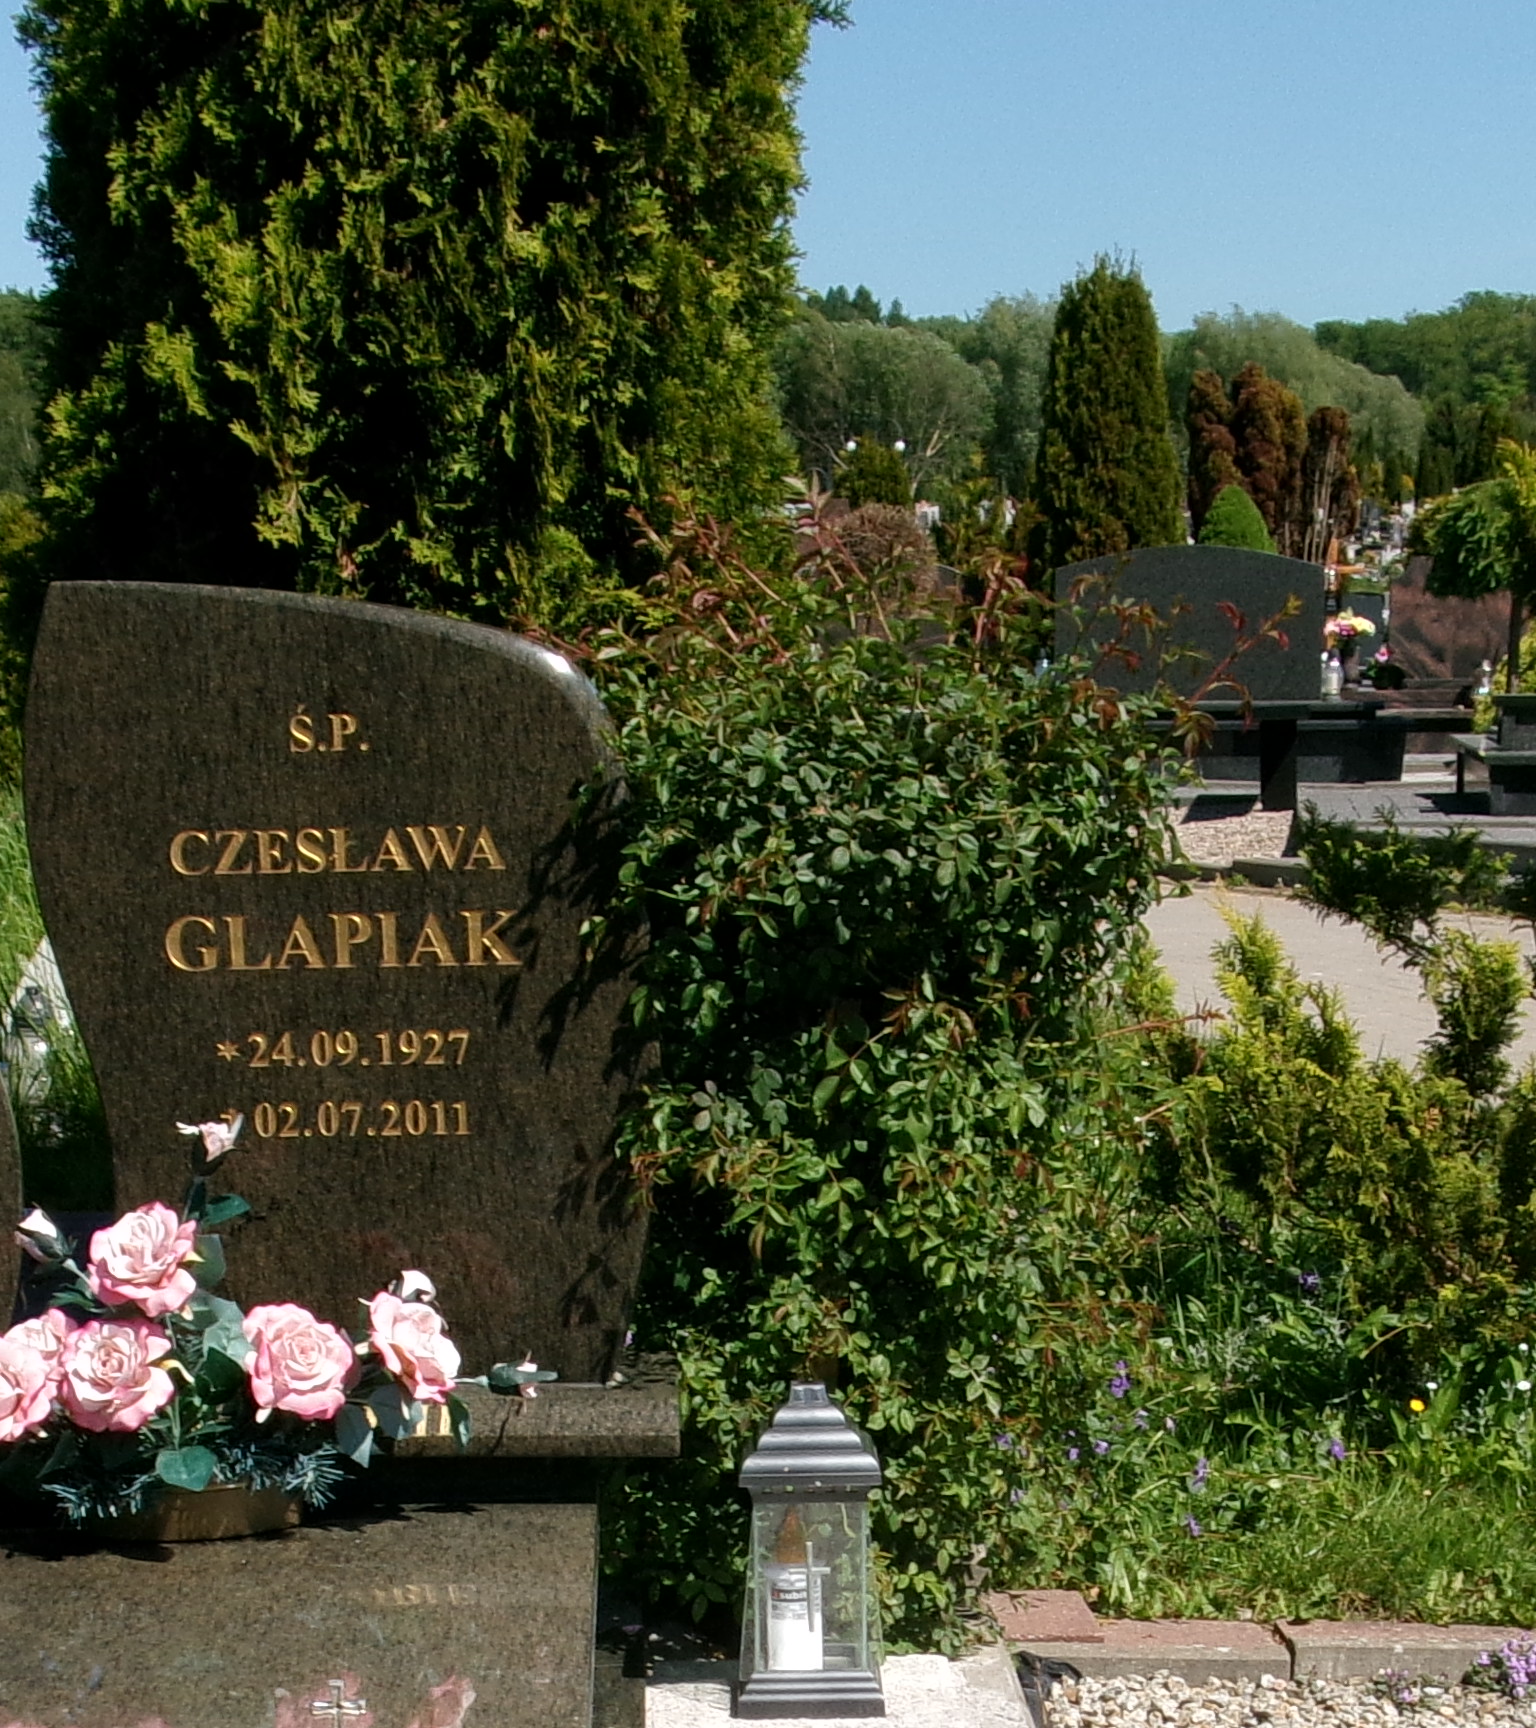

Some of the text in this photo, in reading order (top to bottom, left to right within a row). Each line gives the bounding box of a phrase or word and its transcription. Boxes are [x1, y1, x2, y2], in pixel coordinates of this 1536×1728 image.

[169, 824, 507, 876] CZESŁAWA
[164, 909, 524, 972] GLAPIAK
[254, 1100, 473, 1138] 02.07.2011
